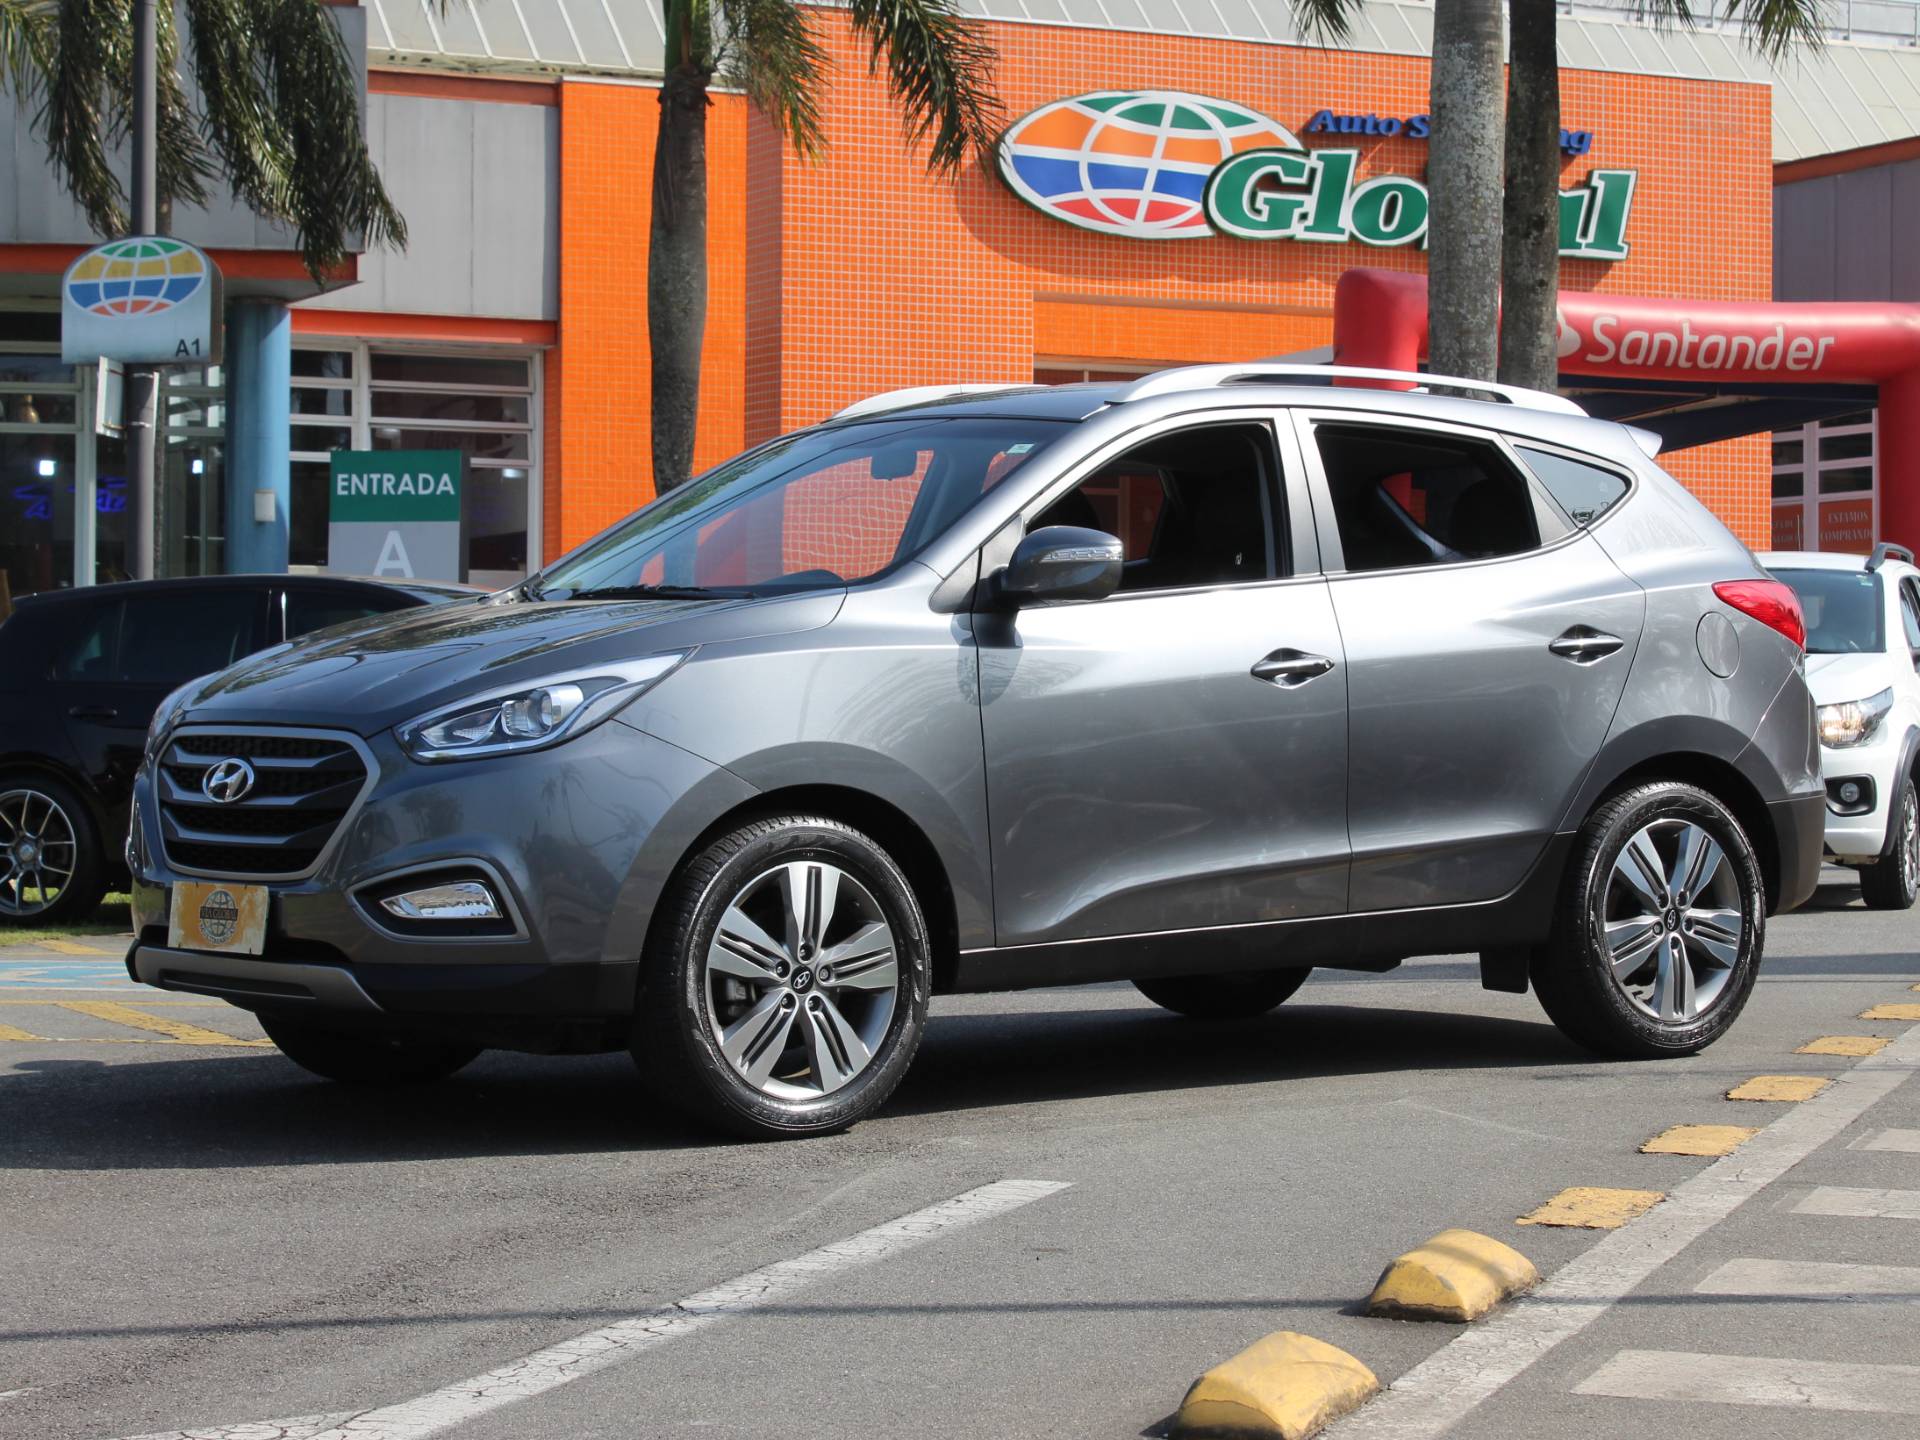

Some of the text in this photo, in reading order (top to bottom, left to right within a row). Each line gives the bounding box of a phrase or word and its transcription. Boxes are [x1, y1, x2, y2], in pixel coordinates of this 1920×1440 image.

[1307, 109, 1400, 137] Auto
[1207, 148, 1639, 261] Glol
[174, 338, 201, 357] A1
[1586, 314, 1835, 371] Santander
[336, 473, 456, 496] ENTRADA
[373, 530, 415, 578] A
